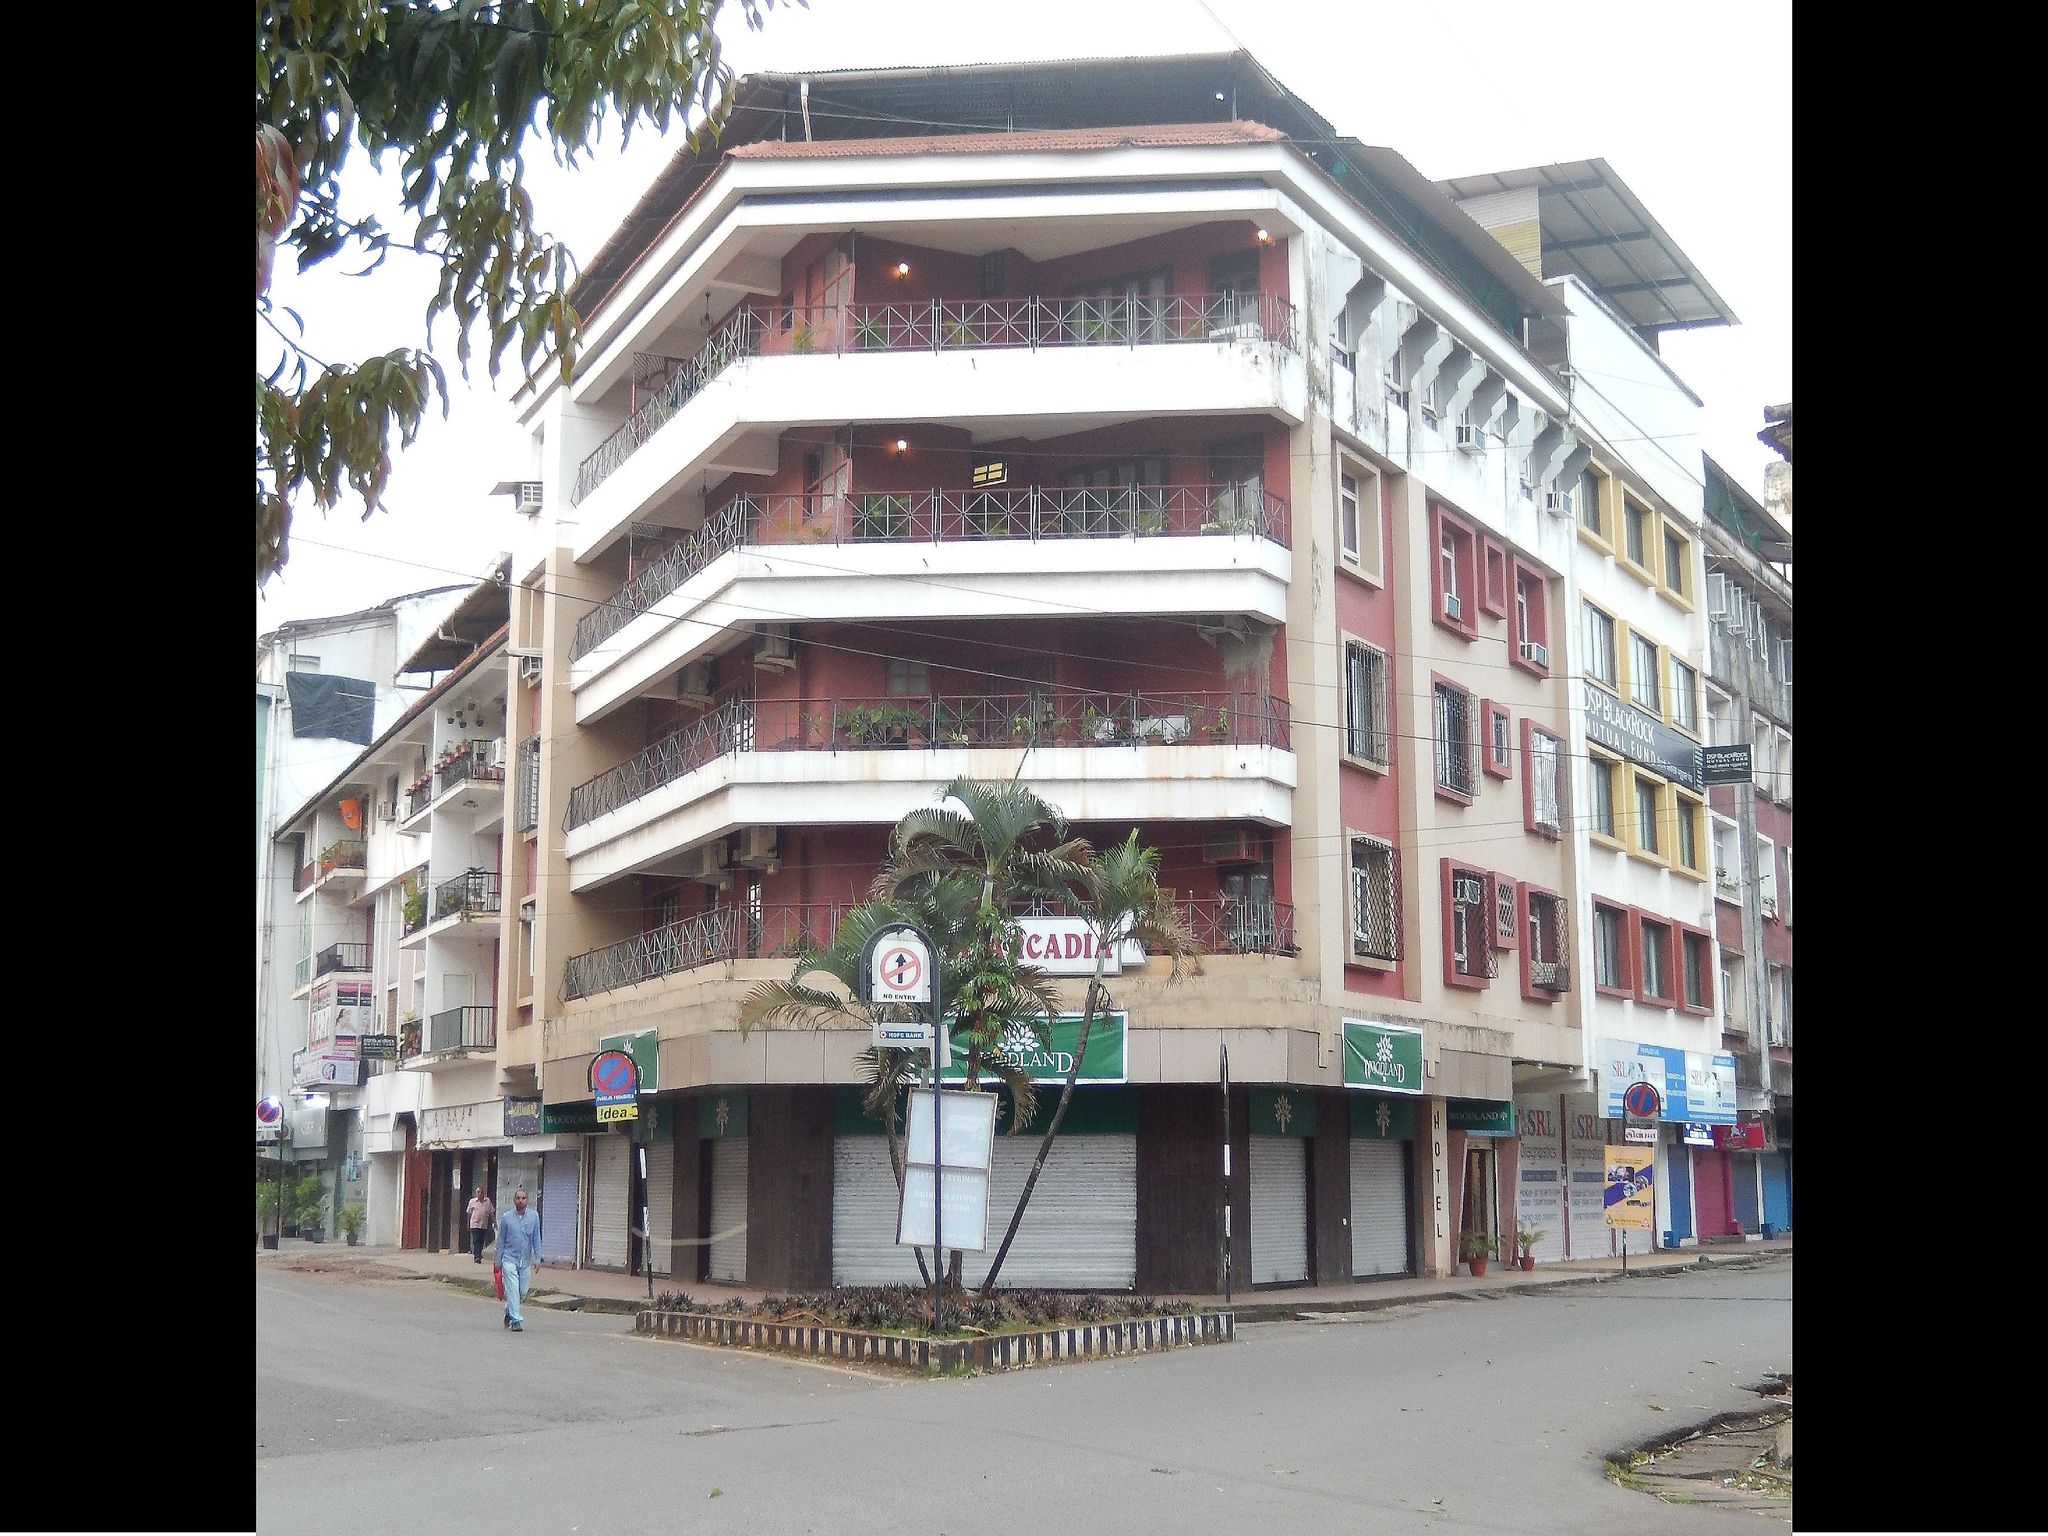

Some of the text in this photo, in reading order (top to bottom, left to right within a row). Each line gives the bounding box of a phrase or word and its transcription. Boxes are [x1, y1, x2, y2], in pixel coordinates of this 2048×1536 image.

[1584, 685, 1603, 717] DSP
[1585, 718, 1656, 764] MUTUAL FUND
[962, 1050, 1074, 1074] DLAND
[1364, 1060, 1405, 1083] WOODLAND
[1449, 1111, 1499, 1121] WOODLAND
[1527, 1110, 1556, 1136] SRL
[1433, 1111, 1443, 1238] HOTEL
